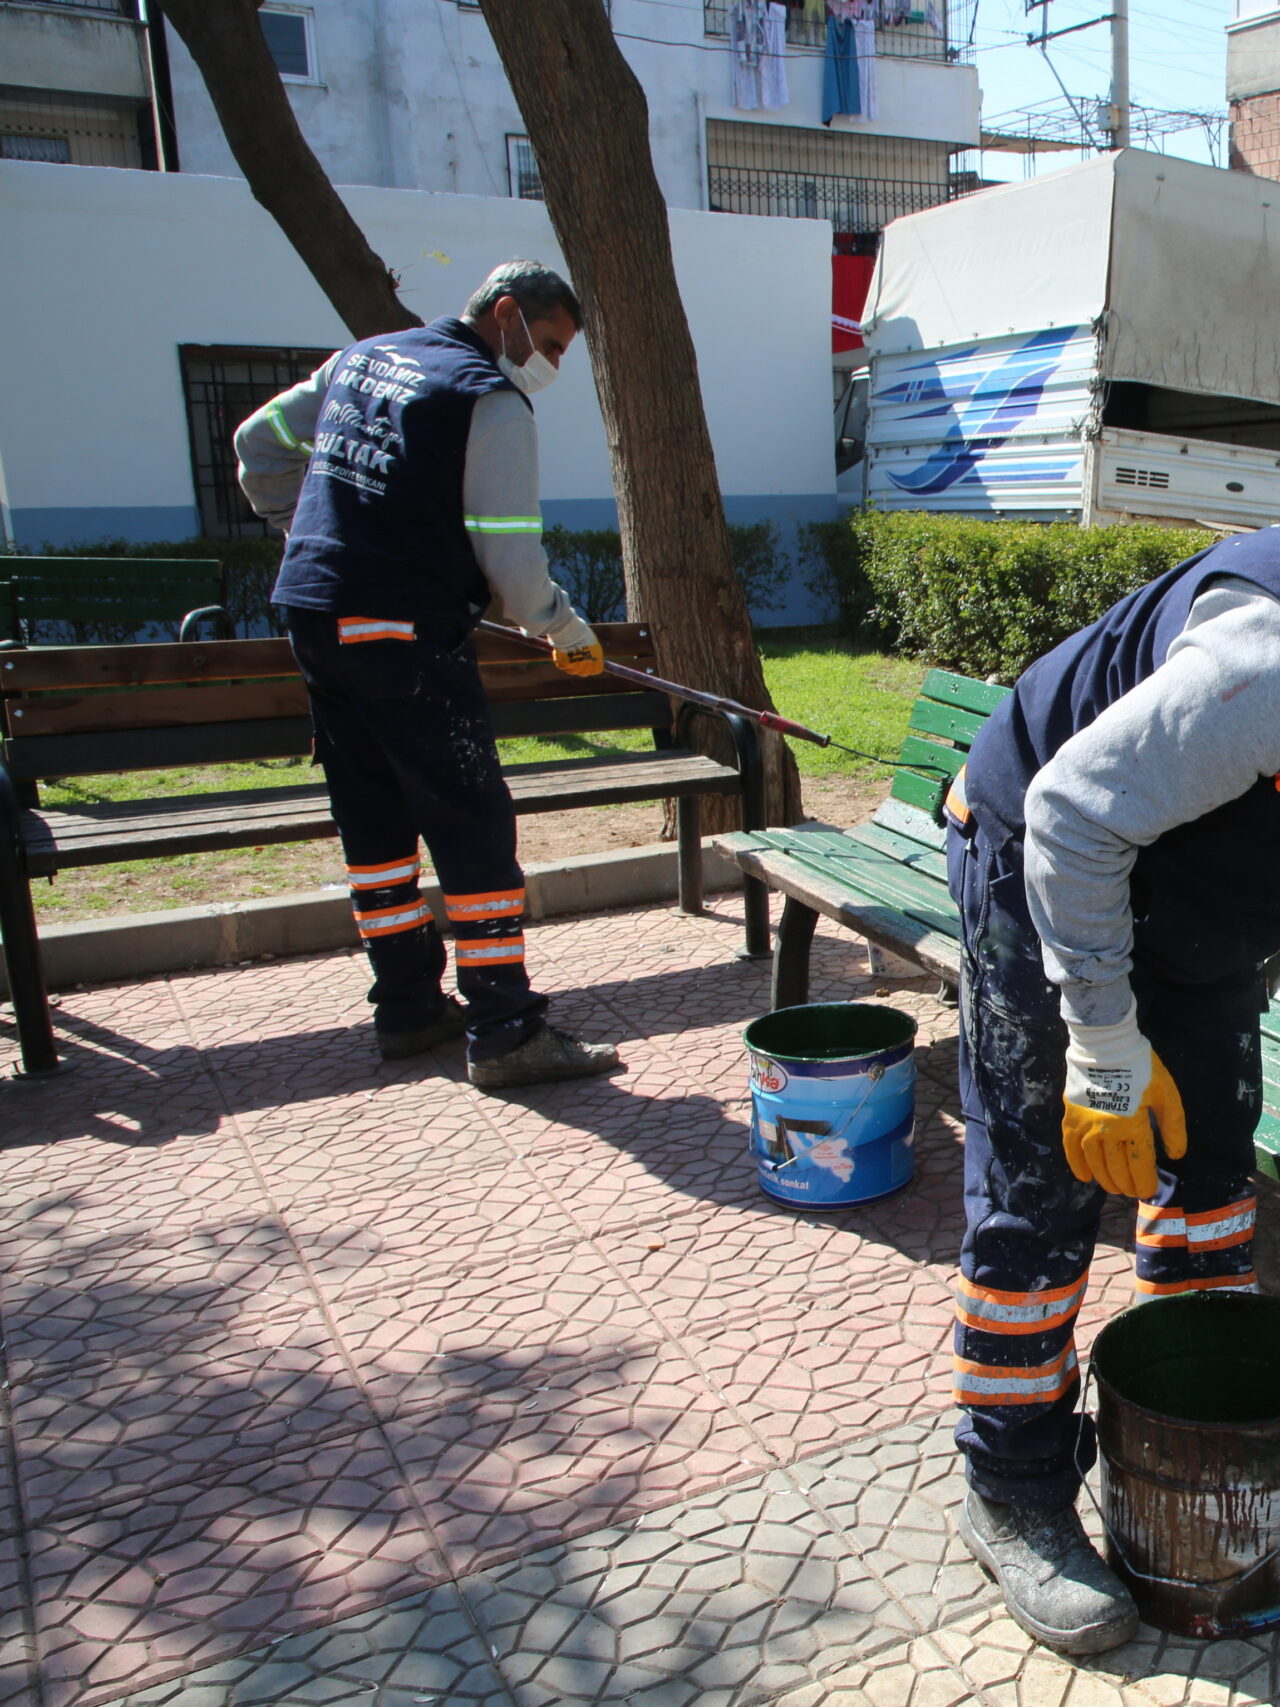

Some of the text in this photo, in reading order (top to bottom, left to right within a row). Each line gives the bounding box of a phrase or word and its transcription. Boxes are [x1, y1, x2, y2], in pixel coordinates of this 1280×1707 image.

[335, 369, 417, 406] AKDENİZ
[346, 353, 427, 388] SEVDAMIZ
[315, 432, 396, 475] GÜLTAK
